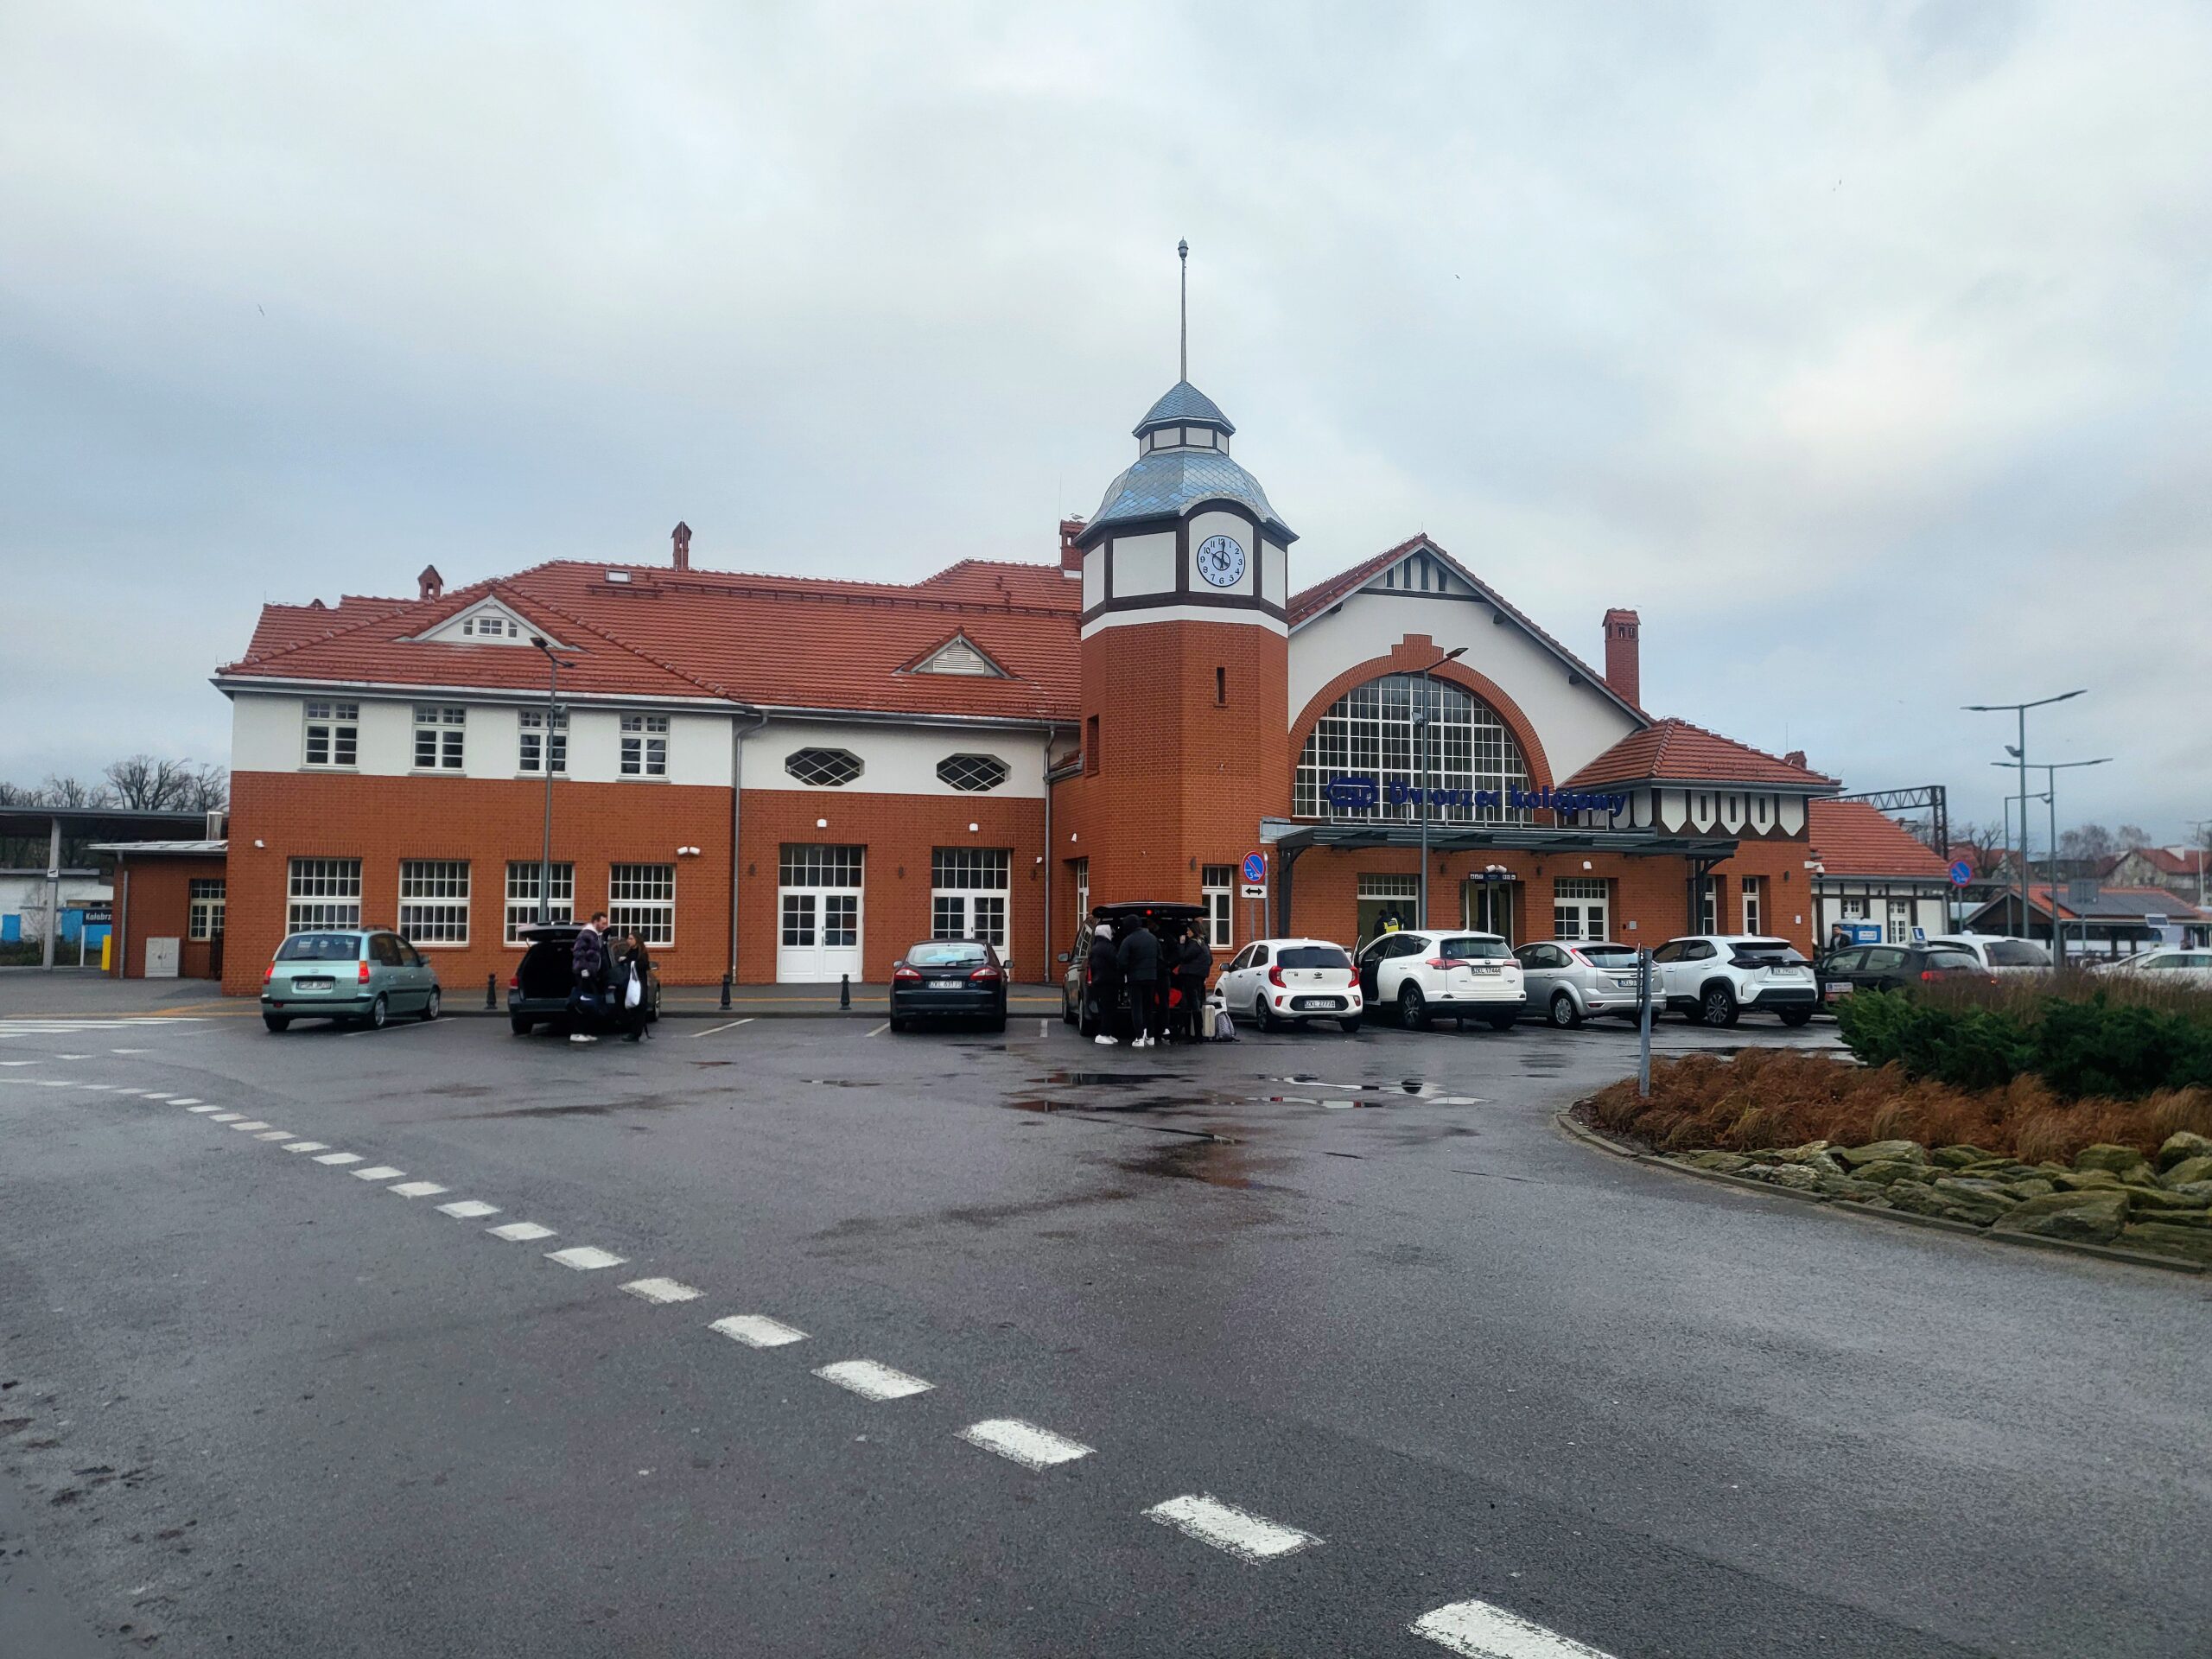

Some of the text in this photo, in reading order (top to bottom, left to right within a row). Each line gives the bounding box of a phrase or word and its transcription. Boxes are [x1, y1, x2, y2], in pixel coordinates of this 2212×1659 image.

[1389, 779, 1502, 807] Dworzec
[1510, 785, 1625, 817] kolejowy
[1915, 929, 1923, 938] L
